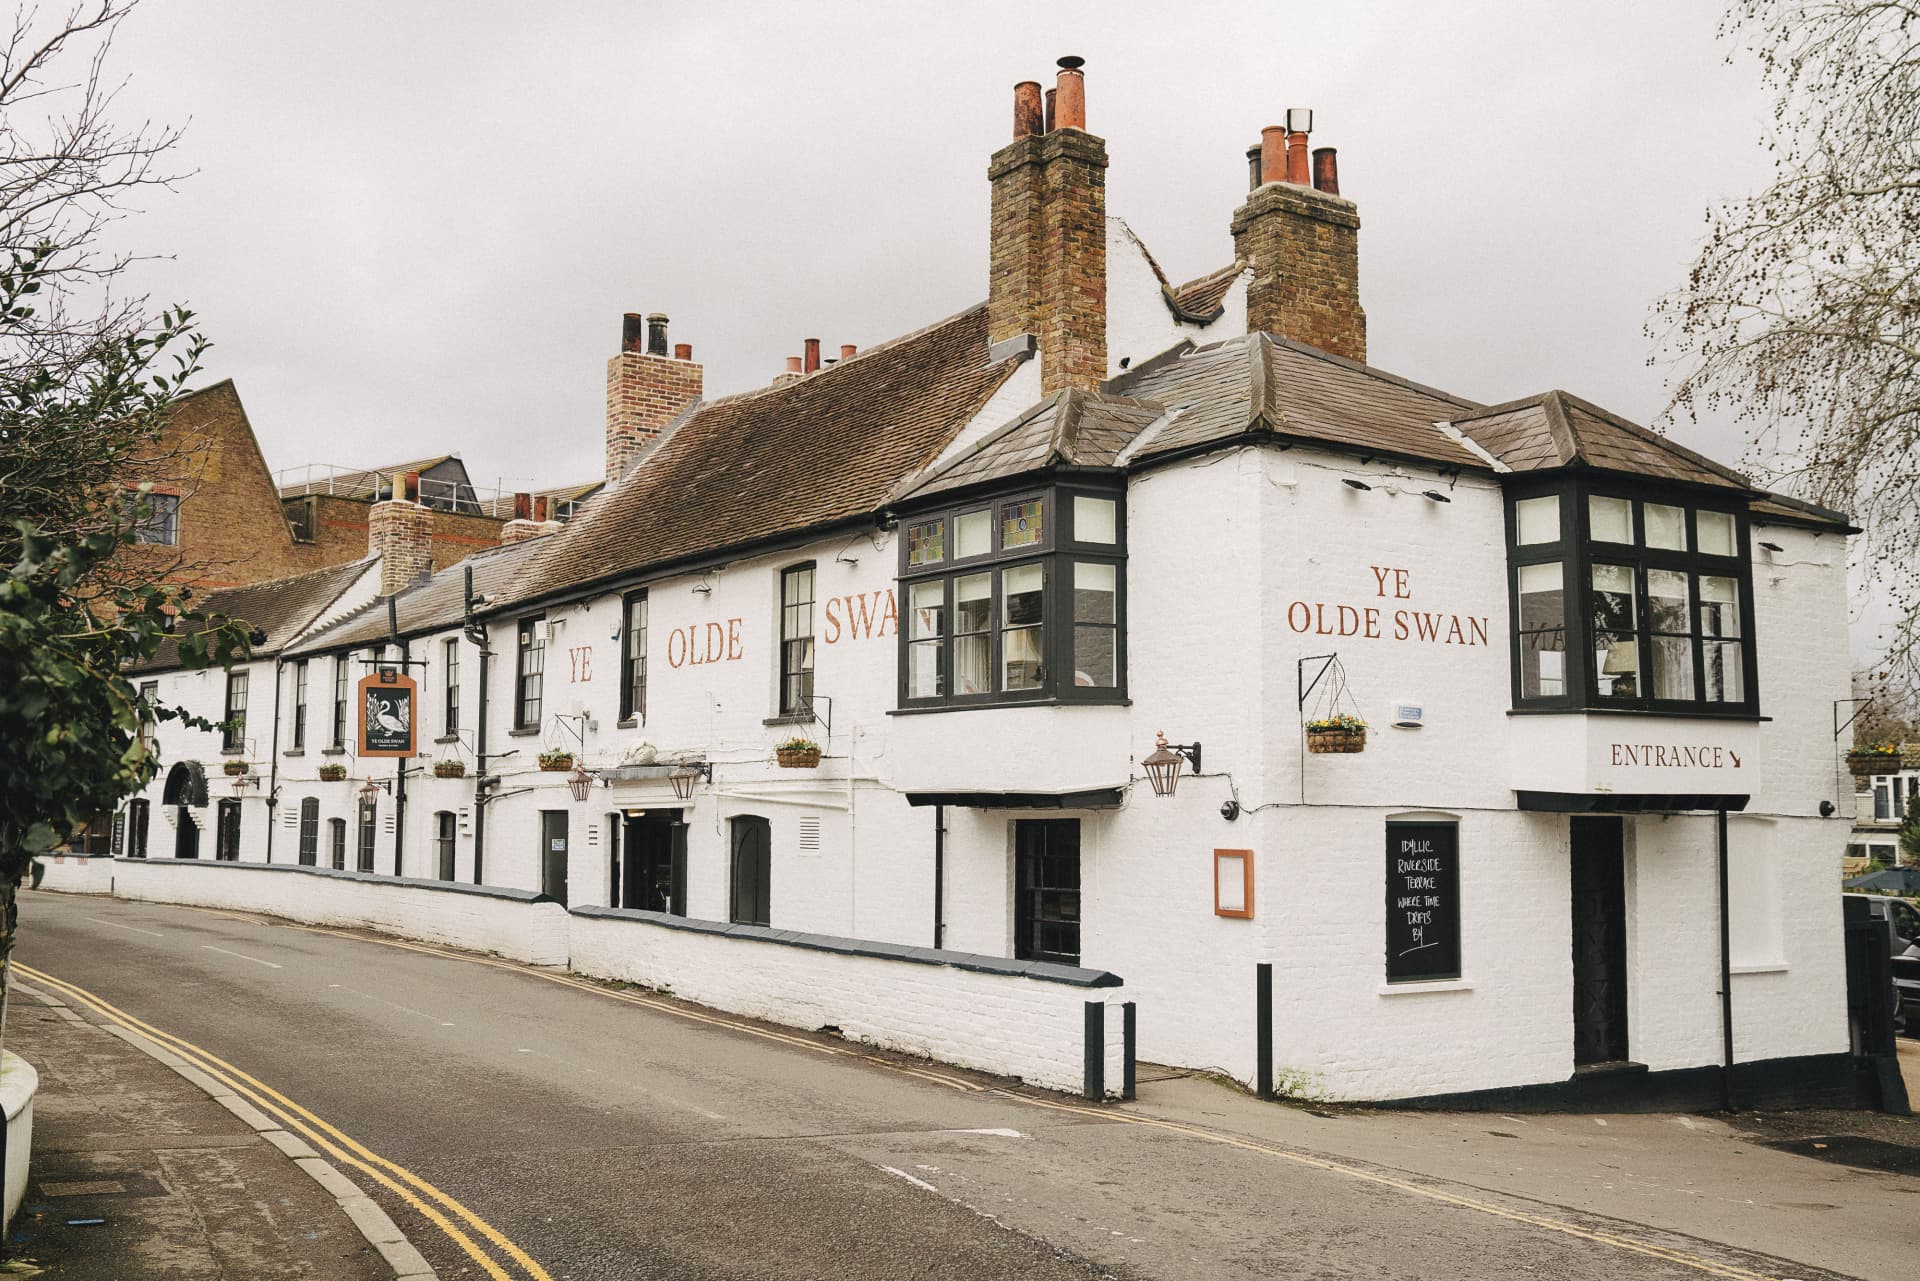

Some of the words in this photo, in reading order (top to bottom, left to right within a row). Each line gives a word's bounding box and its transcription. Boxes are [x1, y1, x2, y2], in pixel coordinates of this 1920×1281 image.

[1370, 565, 1411, 599] YE
[1288, 601, 1381, 639] OLDE
[1394, 610, 1488, 647] SWAN
[568, 646, 593, 683] YE
[668, 618, 743, 669] OLDE
[1611, 744, 1723, 768] ENTRANCE
[1401, 838, 1434, 856] IDYLLIC
[1398, 858, 1442, 874] RIVERSIDE
[1404, 876, 1437, 890] TERRACE
[1397, 895, 1422, 909] WHERE
[1424, 895, 1440, 907] TIME
[1406, 910, 1432, 925] DRIFTS
[1412, 925, 1423, 947] BY
